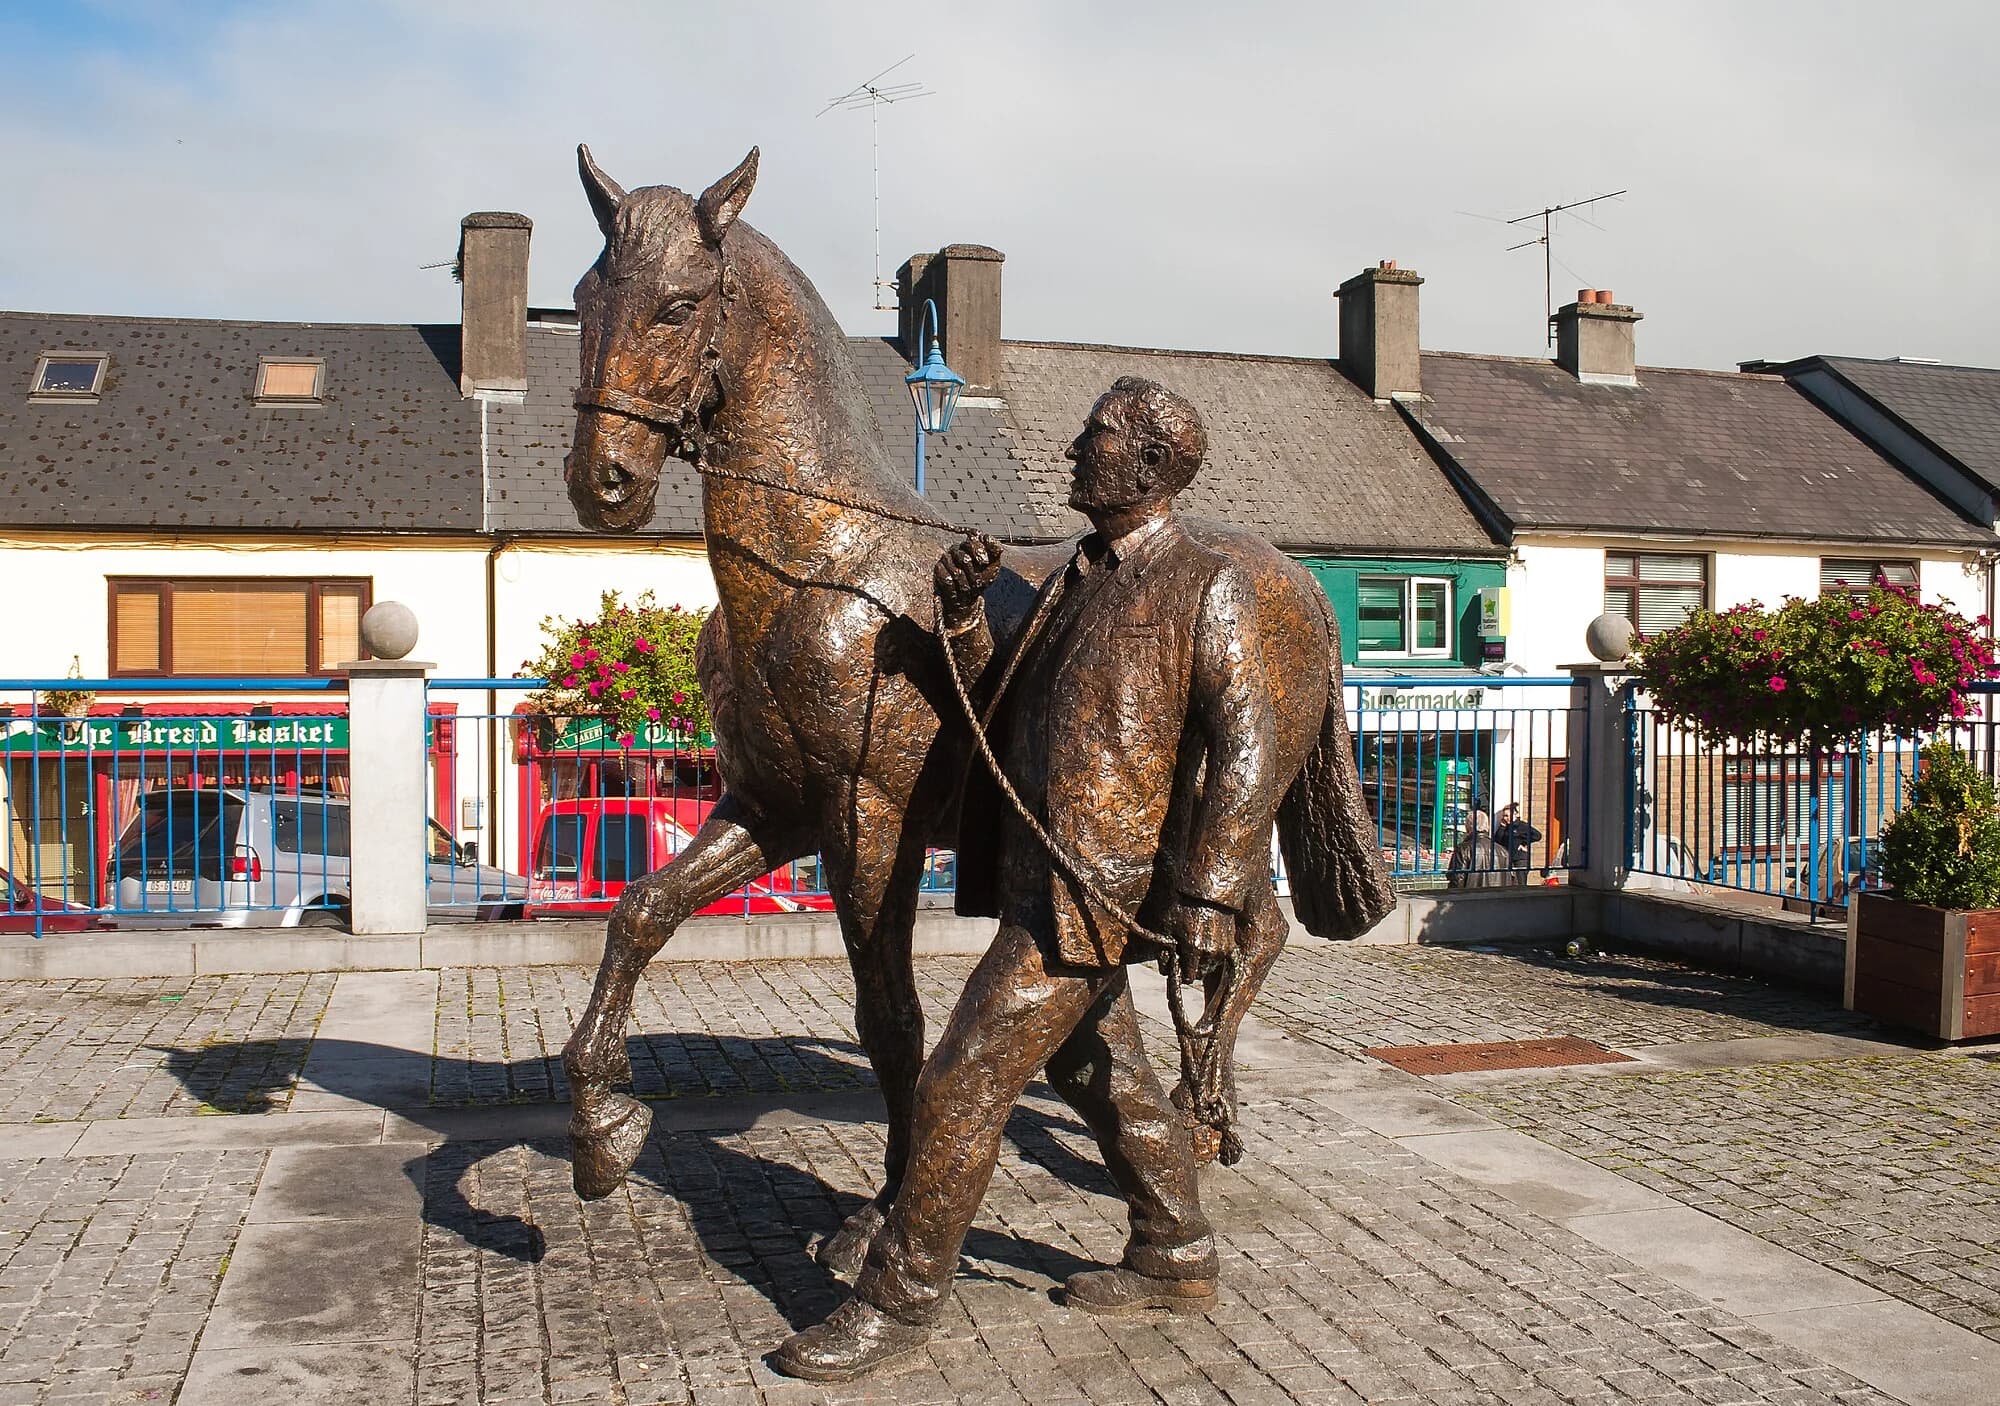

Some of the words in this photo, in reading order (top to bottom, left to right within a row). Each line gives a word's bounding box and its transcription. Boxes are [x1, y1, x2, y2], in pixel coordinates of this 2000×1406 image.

[1360, 689, 1483, 717] Supermarket
[128, 719, 218, 746] Bread
[231, 719, 335, 745] Basket
